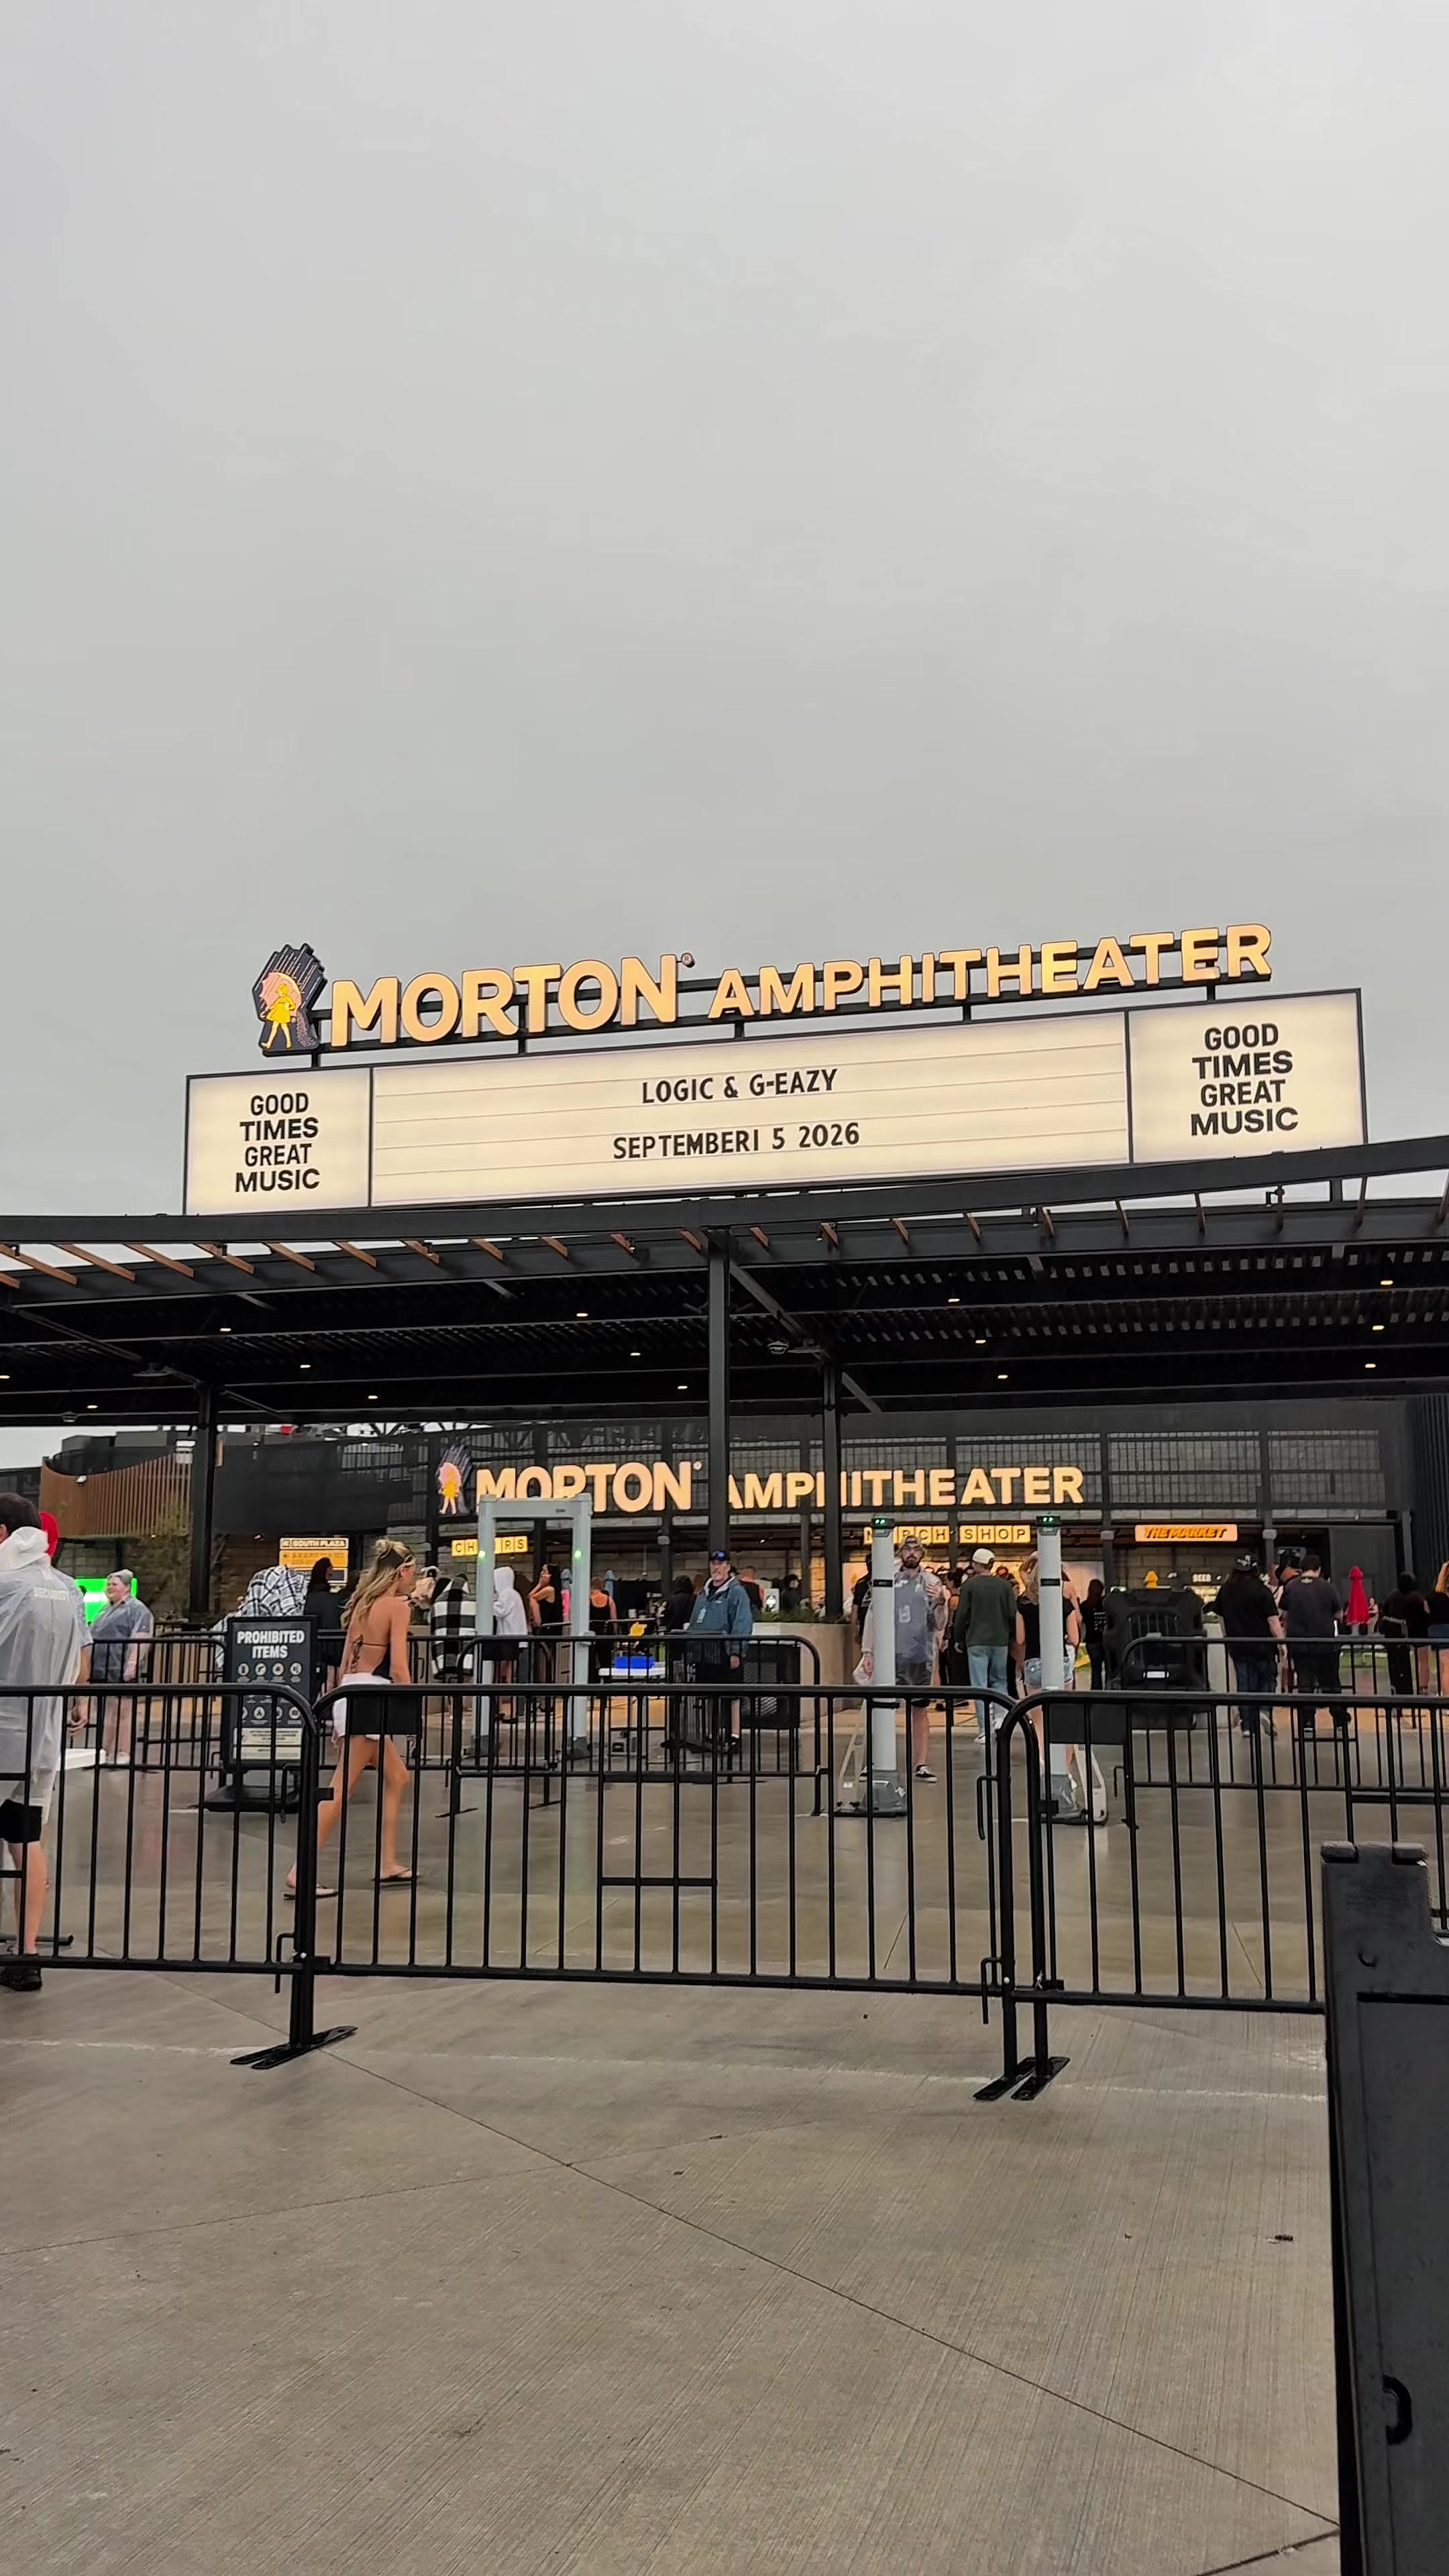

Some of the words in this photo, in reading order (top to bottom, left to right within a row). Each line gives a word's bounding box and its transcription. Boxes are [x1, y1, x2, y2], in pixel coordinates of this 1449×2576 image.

[706, 922, 1273, 1020] AMPHITHEATER
[1203, 1023, 1279, 1050] GOOD
[1191, 1051, 1293, 1079] TIMES
[641, 1077, 714, 1104] LOGIC
[723, 1075, 739, 1098] &
[749, 1068, 839, 1097] G-EAZY
[1200, 1079, 1286, 1108] GREAT
[250, 1092, 310, 1116] GOOD
[239, 1116, 319, 1142] TIMES
[1191, 1107, 1298, 1136] MUSIC
[771, 1126, 786, 1150] 5
[798, 1122, 861, 1148] 2026
[244, 1142, 313, 1167] GREAT
[235, 1167, 321, 1193] MUSIC
[455, 1539, 524, 1552] CHRS
[964, 1527, 1026, 1541] SHOP
[1144, 1527, 1170, 1538] THE
[1169, 1527, 1228, 1538] MARKET
[237, 1630, 305, 1644] PROHIBITED
[252, 1646, 288, 1658] ITEMS
